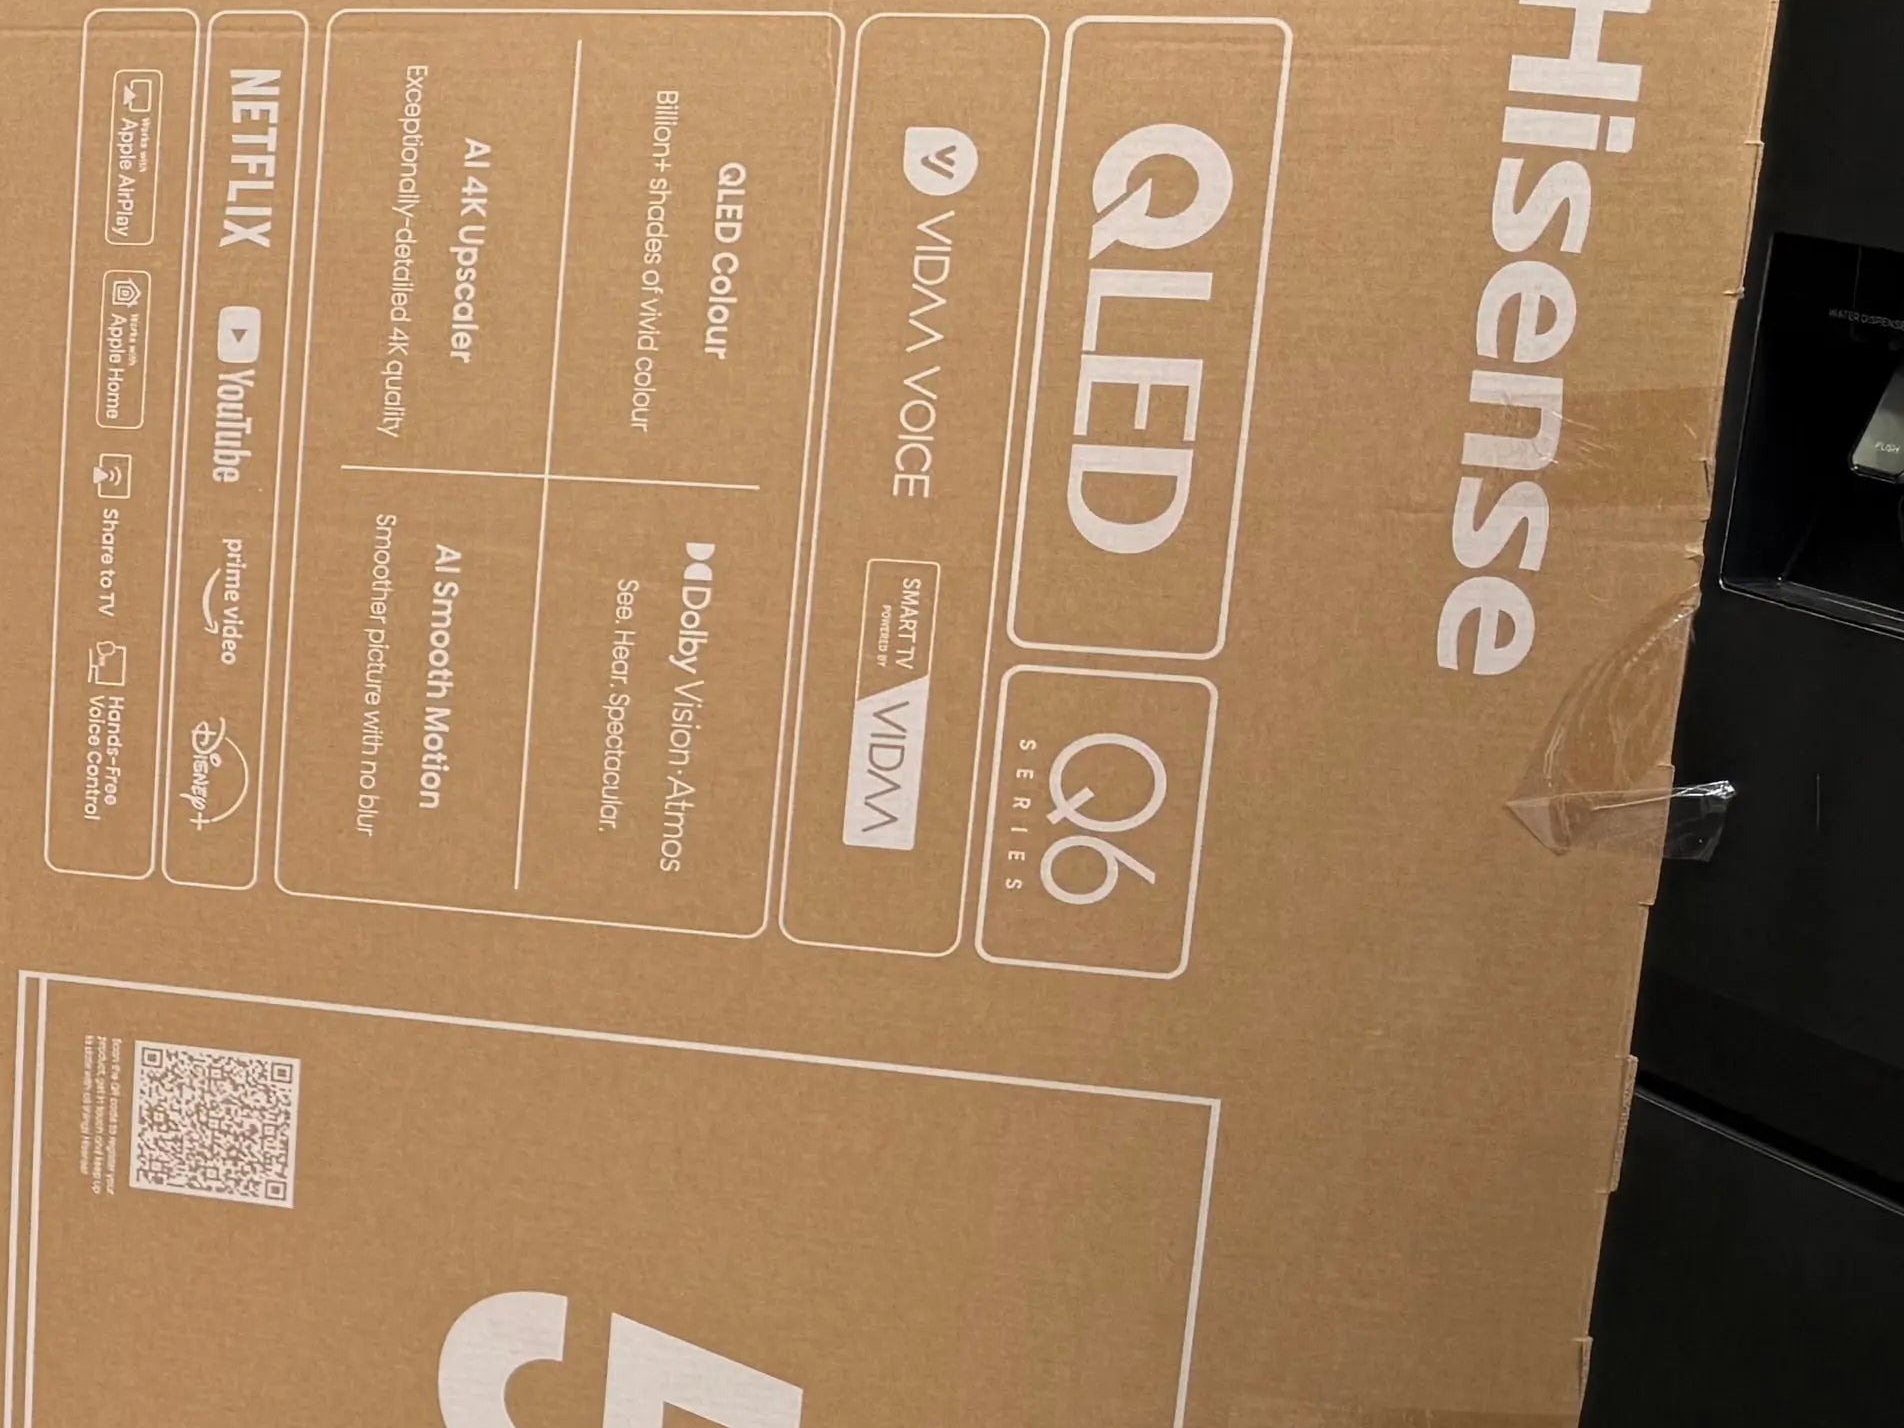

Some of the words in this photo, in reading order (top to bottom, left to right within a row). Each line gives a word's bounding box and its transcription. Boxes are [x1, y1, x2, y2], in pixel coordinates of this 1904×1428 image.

[117, 118, 136, 170] Apple
[219, 69, 281, 247] NETFLIX
[464, 138, 491, 167] AI
[652, 91, 679, 172] Billion+
[112, 174, 133, 236] AirPlay
[391, 66, 428, 321] Exceptionally-detailed
[461, 176, 488, 217] 4K
[644, 178, 672, 264] shades
[715, 163, 746, 243] QLED
[450, 226, 486, 363] Upscaler
[642, 270, 663, 294] of
[705, 252, 739, 359] Colour
[107, 313, 127, 363] Apple
[388, 327, 409, 355] 4K
[638, 298, 662, 351] vivid
[1067, 123, 1237, 560] QLED
[106, 368, 122, 418] Home
[377, 360, 405, 437] quality
[631, 357, 656, 432] colour
[213, 369, 255, 482] YouTube
[893, 366, 940, 497] VOICE
[101, 509, 119, 564] Share
[435, 544, 461, 573] AI
[100, 570, 115, 588] to
[222, 539, 246, 602] prime
[370, 514, 396, 624] Smoother
[99, 593, 114, 616] TV
[616, 579, 639, 623] See.
[669, 587, 711, 674] Dolby
[878, 605, 891, 652] POWERED
[898, 578, 921, 643] SMART
[221, 607, 243, 664] video
[364, 629, 389, 705] picture
[427, 582, 459, 698] Smooth
[610, 631, 636, 687] Hear.
[877, 655, 887, 667] BY
[896, 647, 915, 669] TV
[88, 696, 105, 745] Voice
[100, 697, 124, 805] Hands-Free
[362, 711, 383, 755] with
[84, 751, 102, 820] Control
[360, 761, 376, 789] no
[419, 707, 451, 808] Motion
[599, 694, 630, 831] Spectacular.
[357, 795, 380, 836] blur
[1005, 740, 1036, 889] SERIES
[1040, 733, 1166, 904] Q6
